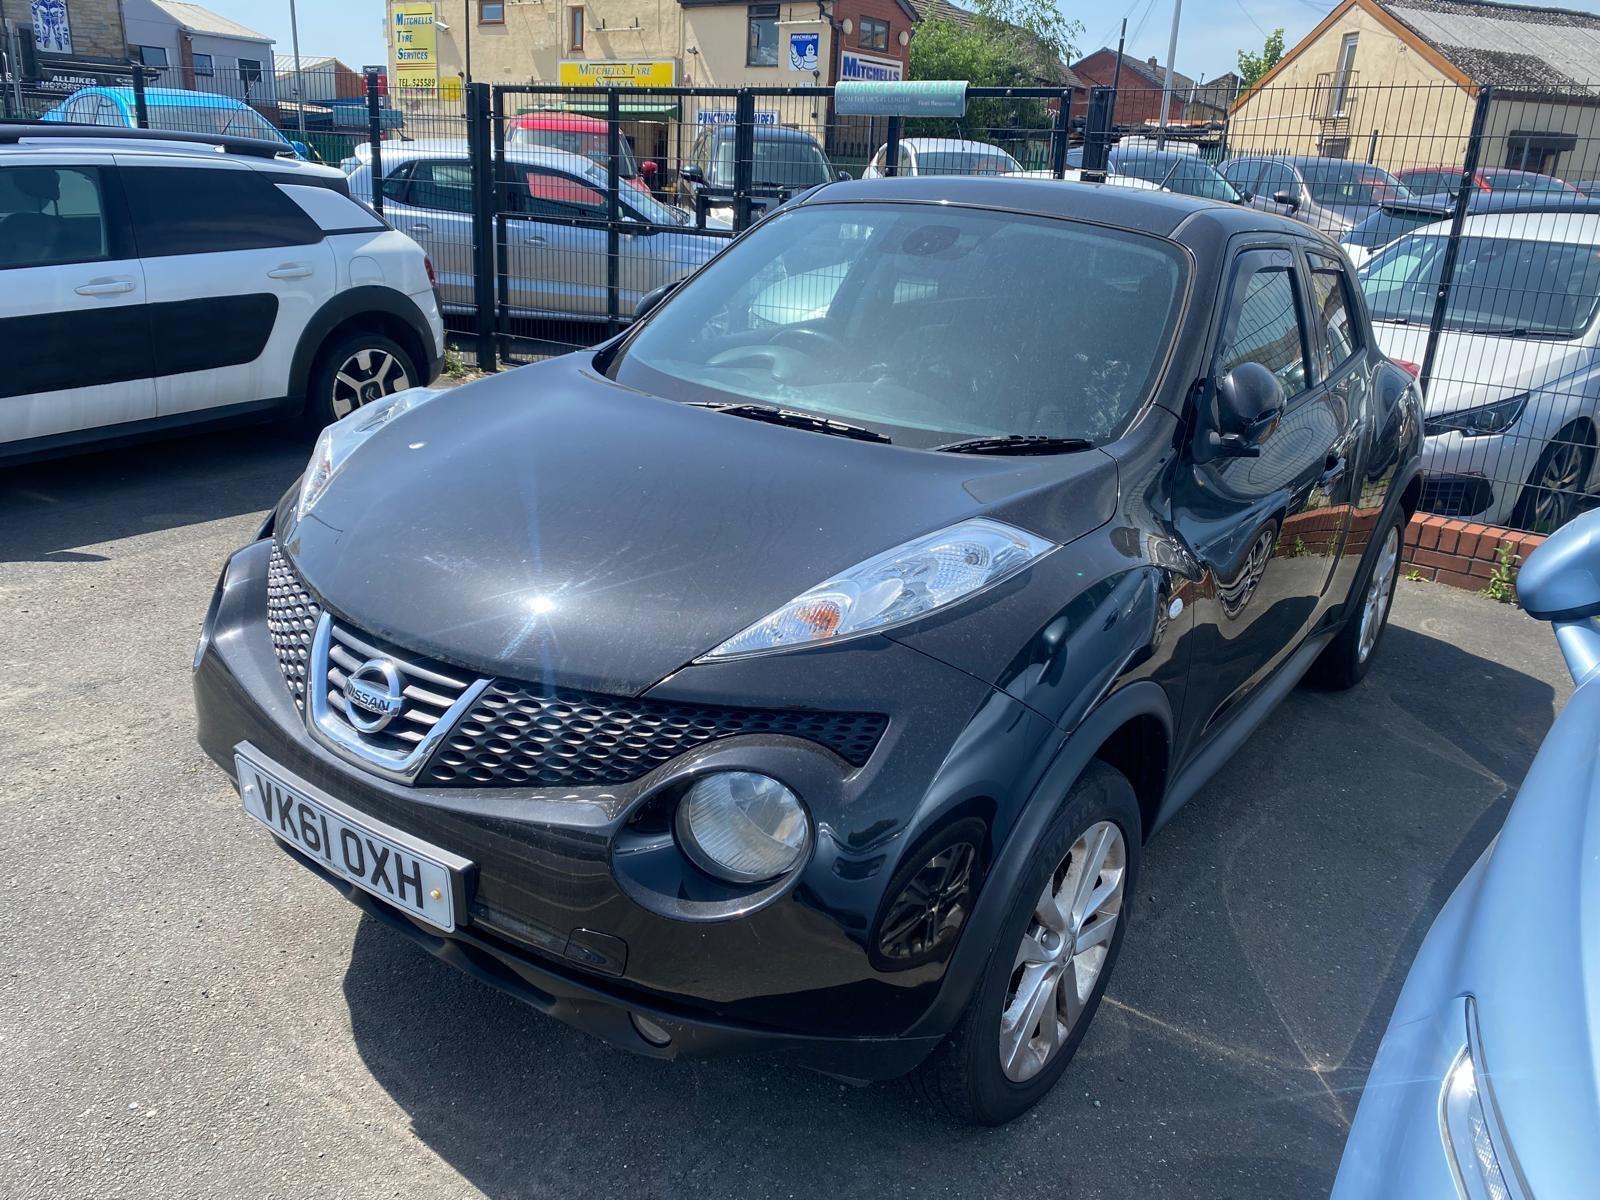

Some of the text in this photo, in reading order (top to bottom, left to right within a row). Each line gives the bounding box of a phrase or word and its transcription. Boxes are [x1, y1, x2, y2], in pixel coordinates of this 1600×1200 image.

[395, 13, 433, 26] MITCHELLS
[396, 31, 413, 43] TYRE
[397, 48, 428, 60] SERVICES
[578, 64, 652, 75] MITCHELLS TYRE
[842, 56, 900, 81] MITCHELLS
[52, 75, 97, 85] ALLBIKES
[894, 82, 963, 95] AVAILABLE
[344, 682, 391, 711] NISSAN
[254, 773, 424, 910] VK61 OXH
